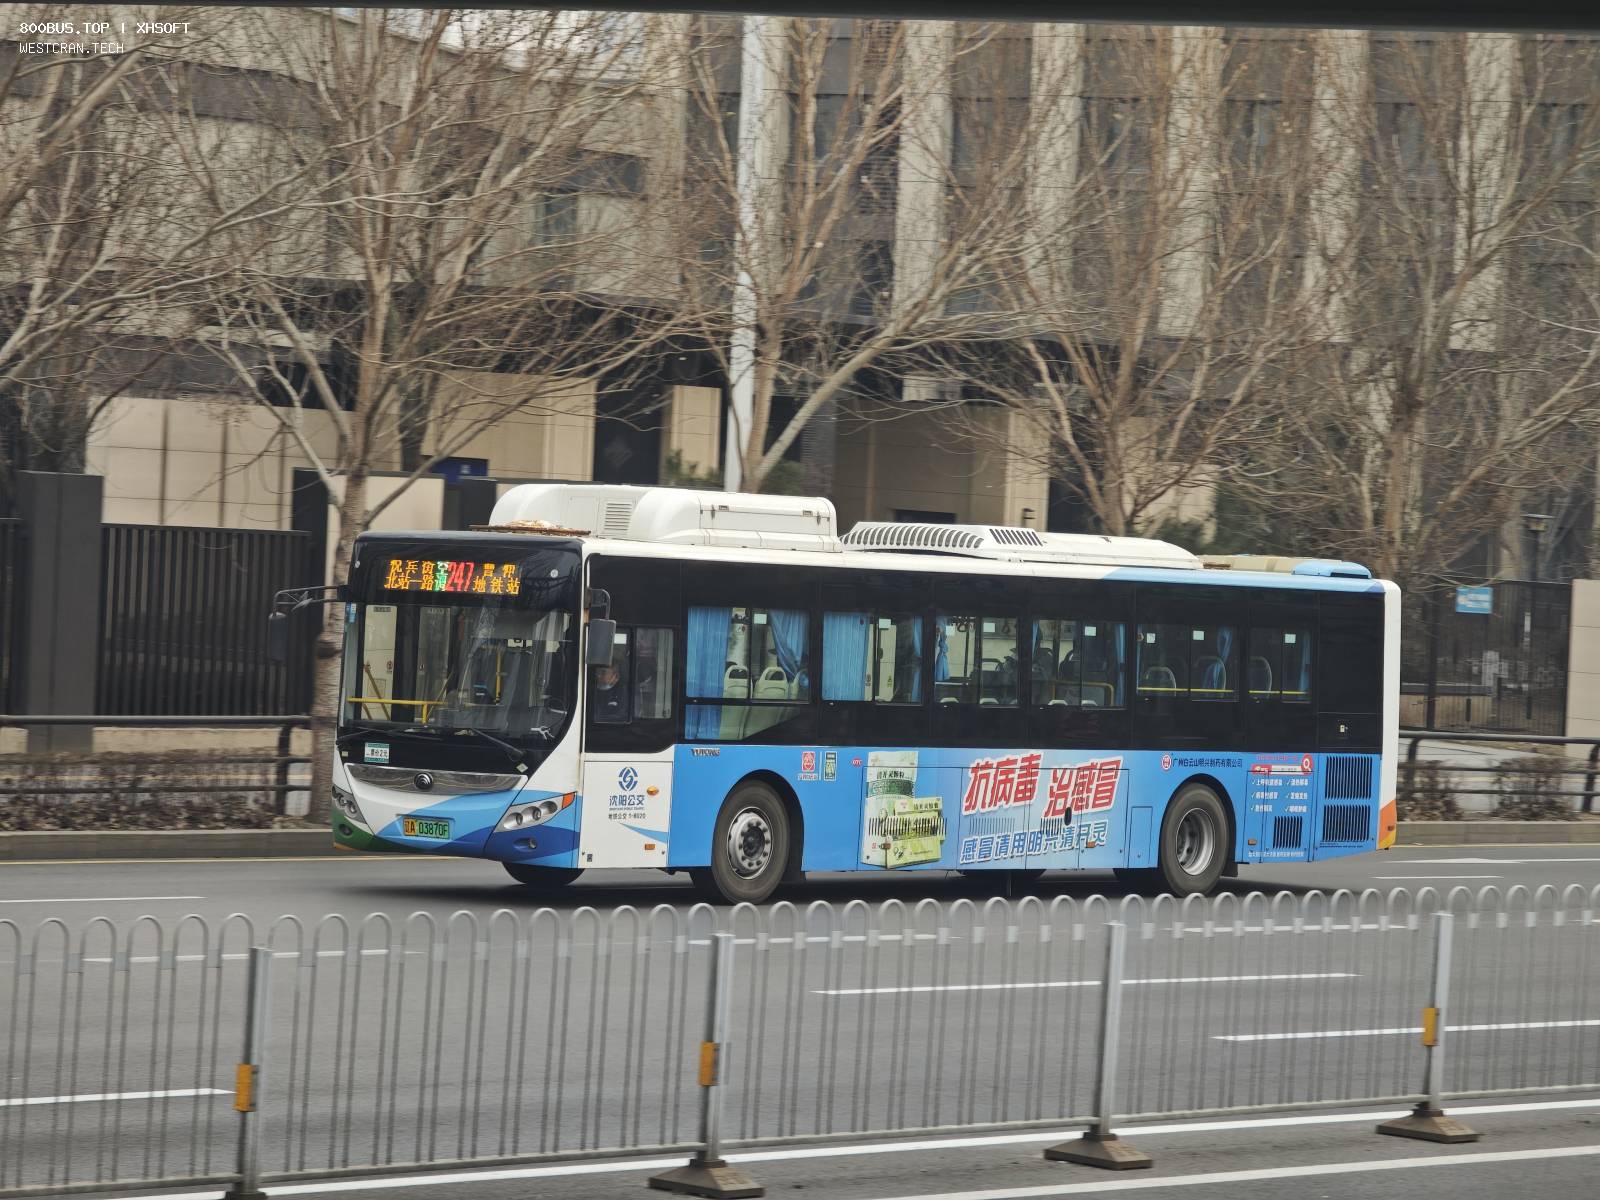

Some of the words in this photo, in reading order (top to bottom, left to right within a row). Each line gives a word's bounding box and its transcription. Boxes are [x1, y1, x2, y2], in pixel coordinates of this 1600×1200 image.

[445, 561, 475, 592] 247
[472, 575, 520, 595] 地铁站
[609, 794, 645, 806] 沈阳公交
[963, 751, 1043, 814] 抗病毒
[1042, 757, 1123, 819] 治感冒
[960, 819, 1108, 864] 感冒请用明兴清开灵
